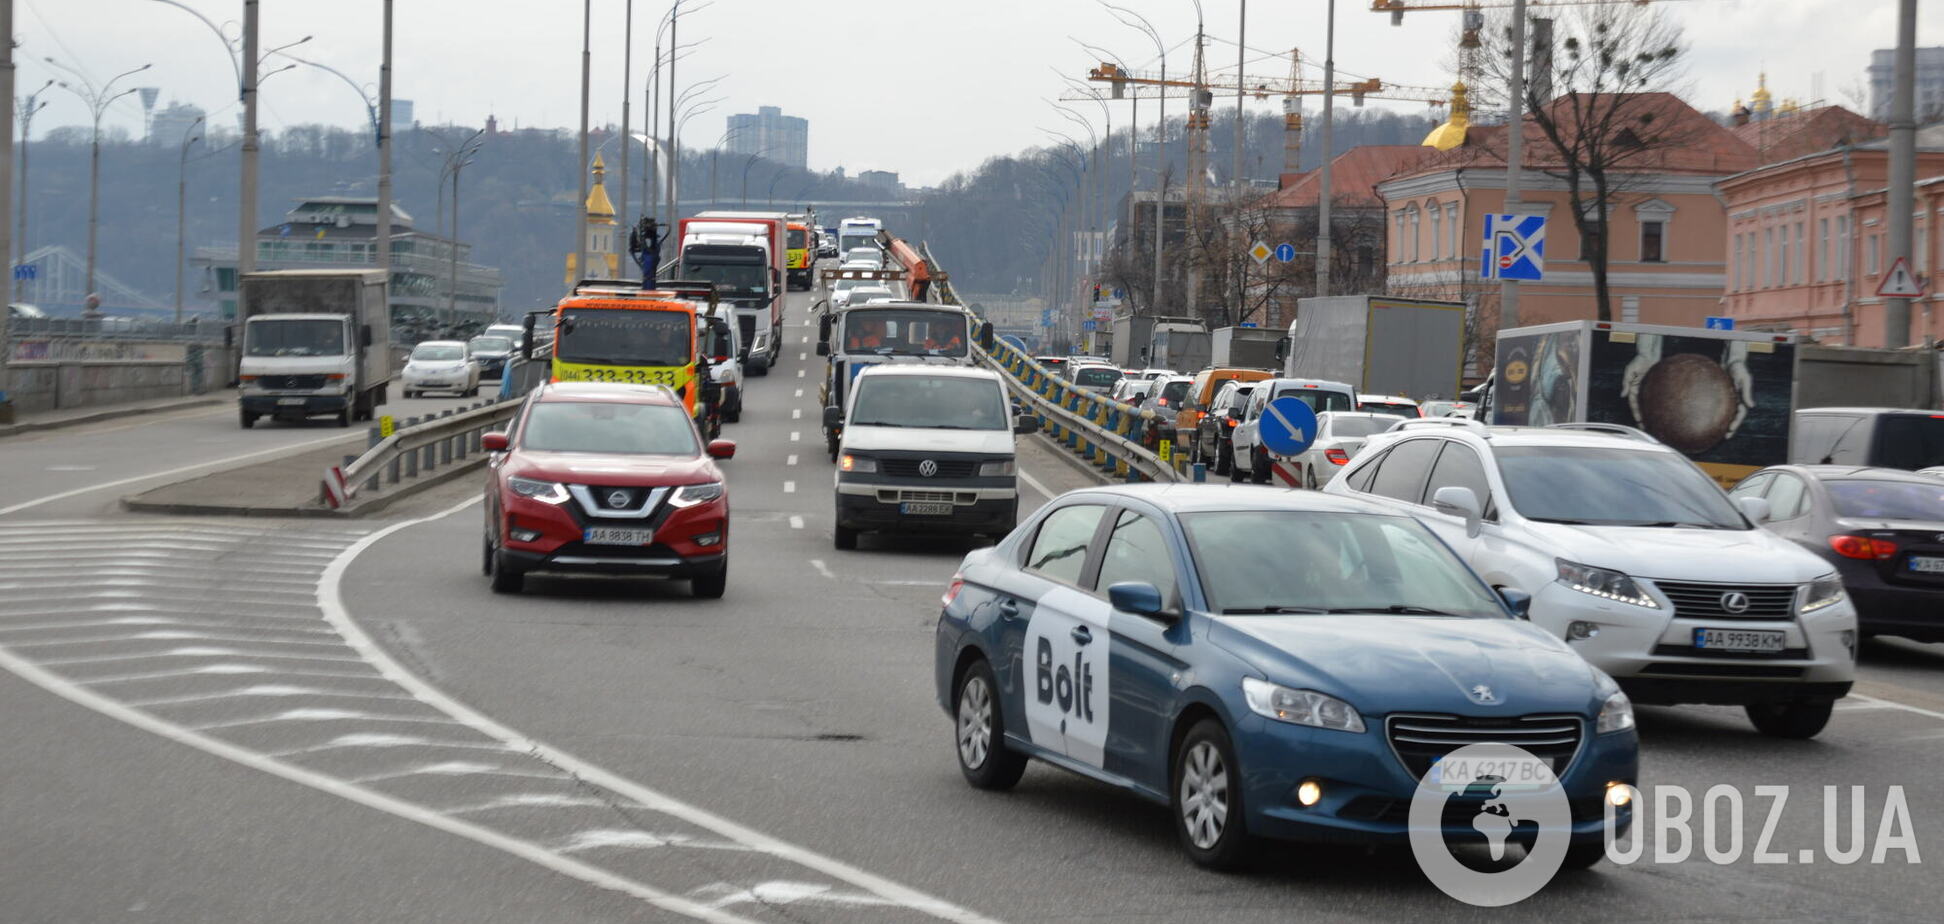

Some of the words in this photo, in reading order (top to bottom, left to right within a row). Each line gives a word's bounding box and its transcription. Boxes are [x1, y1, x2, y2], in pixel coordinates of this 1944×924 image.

[592, 530, 606, 540] AA
[634, 531, 650, 542] TH
[1706, 632, 1724, 646] AA
[1727, 632, 1759, 648] 9938
[1761, 634, 1782, 648] KM
[1037, 635, 1094, 728] Bolt
[1441, 761, 1470, 780] KA
[1475, 761, 1517, 780] 6217
[1520, 761, 1547, 781] BC
